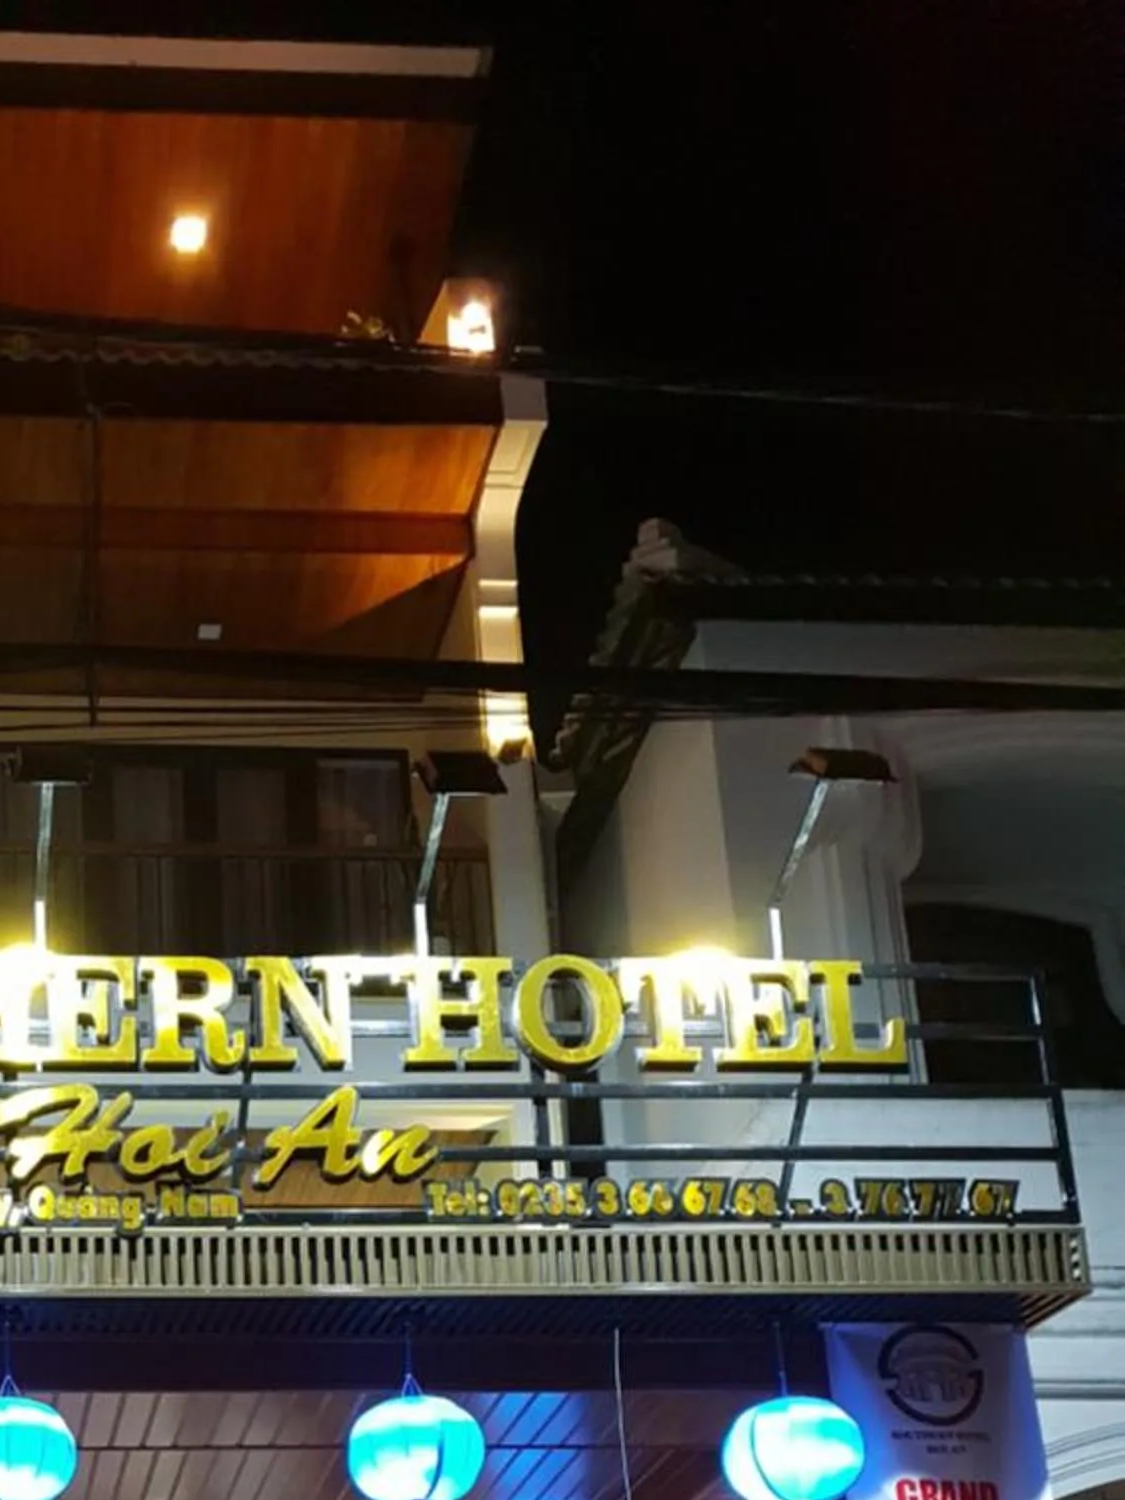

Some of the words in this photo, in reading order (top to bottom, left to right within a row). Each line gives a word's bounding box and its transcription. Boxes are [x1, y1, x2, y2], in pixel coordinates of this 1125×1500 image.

[389, 954, 909, 1072] HOTEL
[252, 1083, 441, 1190] An
[159, 1183, 241, 1217] Nam
[427, 1181, 489, 1216] Tel:
[595, 1181, 620, 1216] 3
